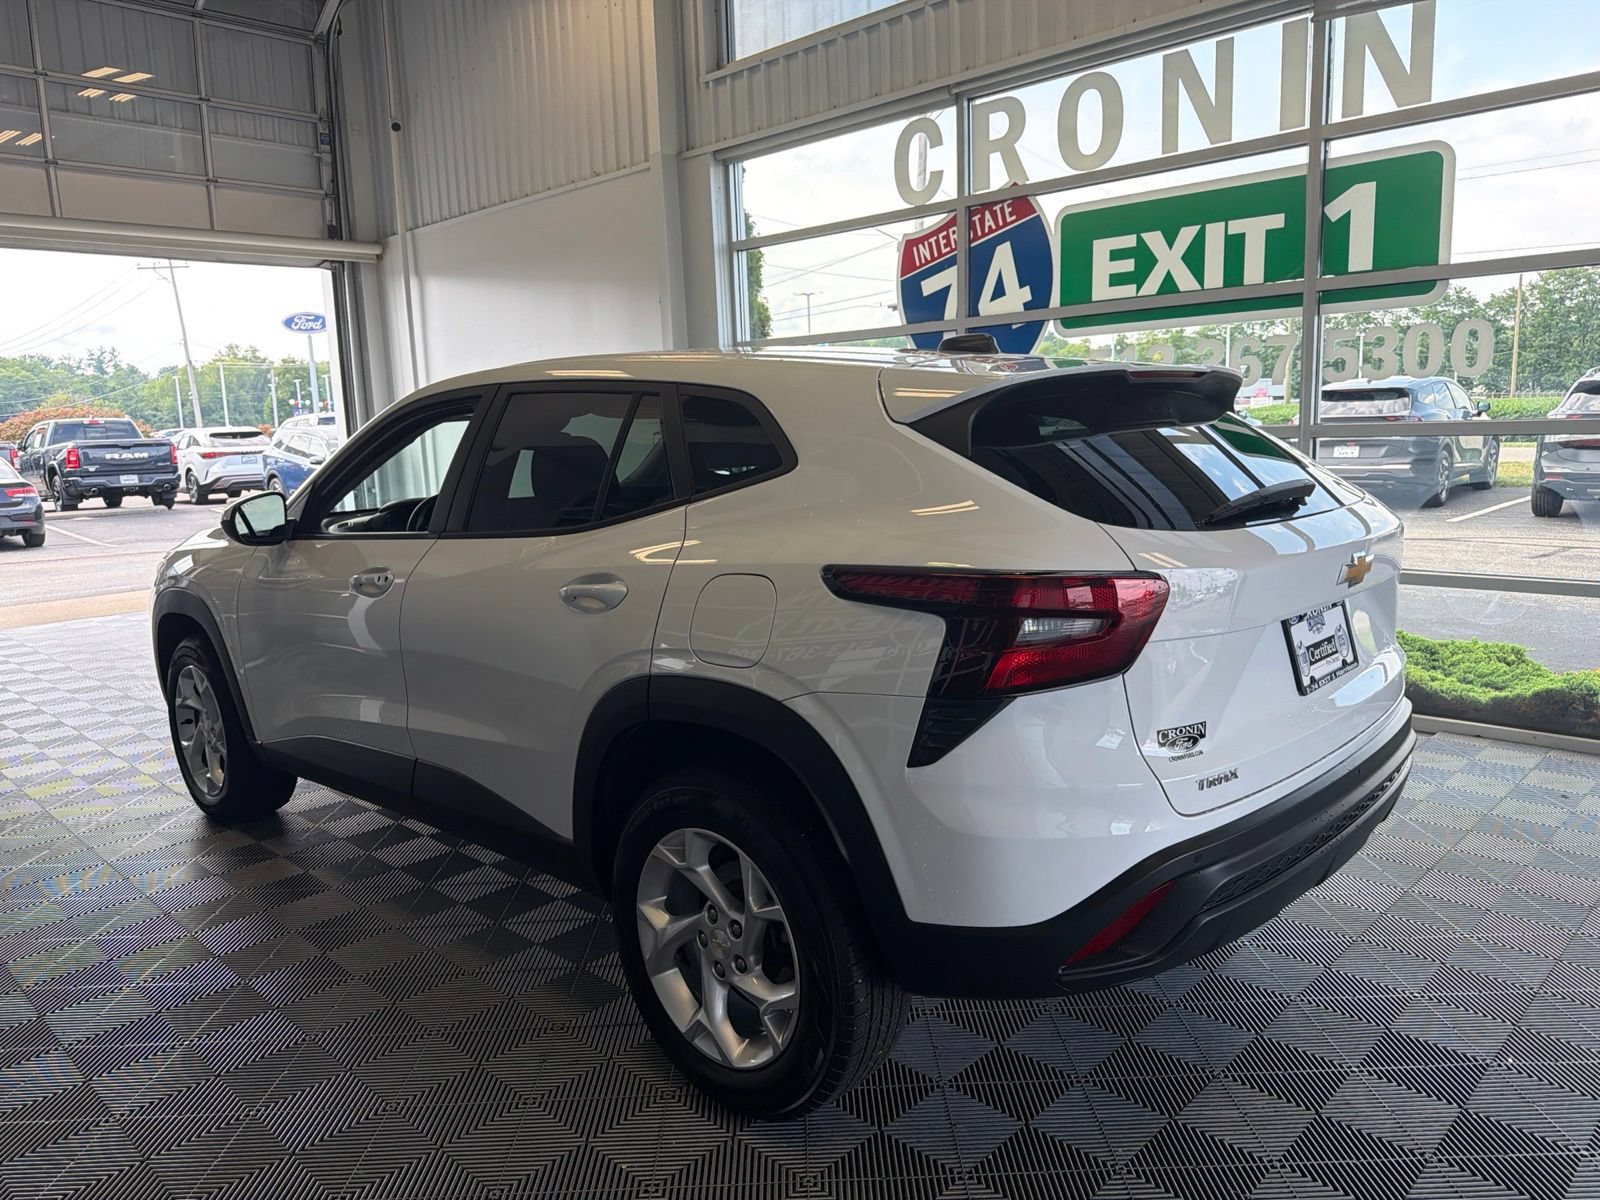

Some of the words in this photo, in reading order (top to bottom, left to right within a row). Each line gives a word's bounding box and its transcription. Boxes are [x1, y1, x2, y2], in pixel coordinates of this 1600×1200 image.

[893, 0, 1437, 206] CRONIN
[912, 199, 1017, 268] INTERTATE
[1092, 213, 1286, 302] EXIT
[1323, 181, 1377, 273] 1
[920, 240, 1033, 350] 74
[291, 315, 323, 330] Ford
[104, 452, 149, 460] RAM
[1309, 639, 1337, 661] Certified
[1158, 722, 1206, 744] CRONIN
[1174, 737, 1194, 750] Ford
